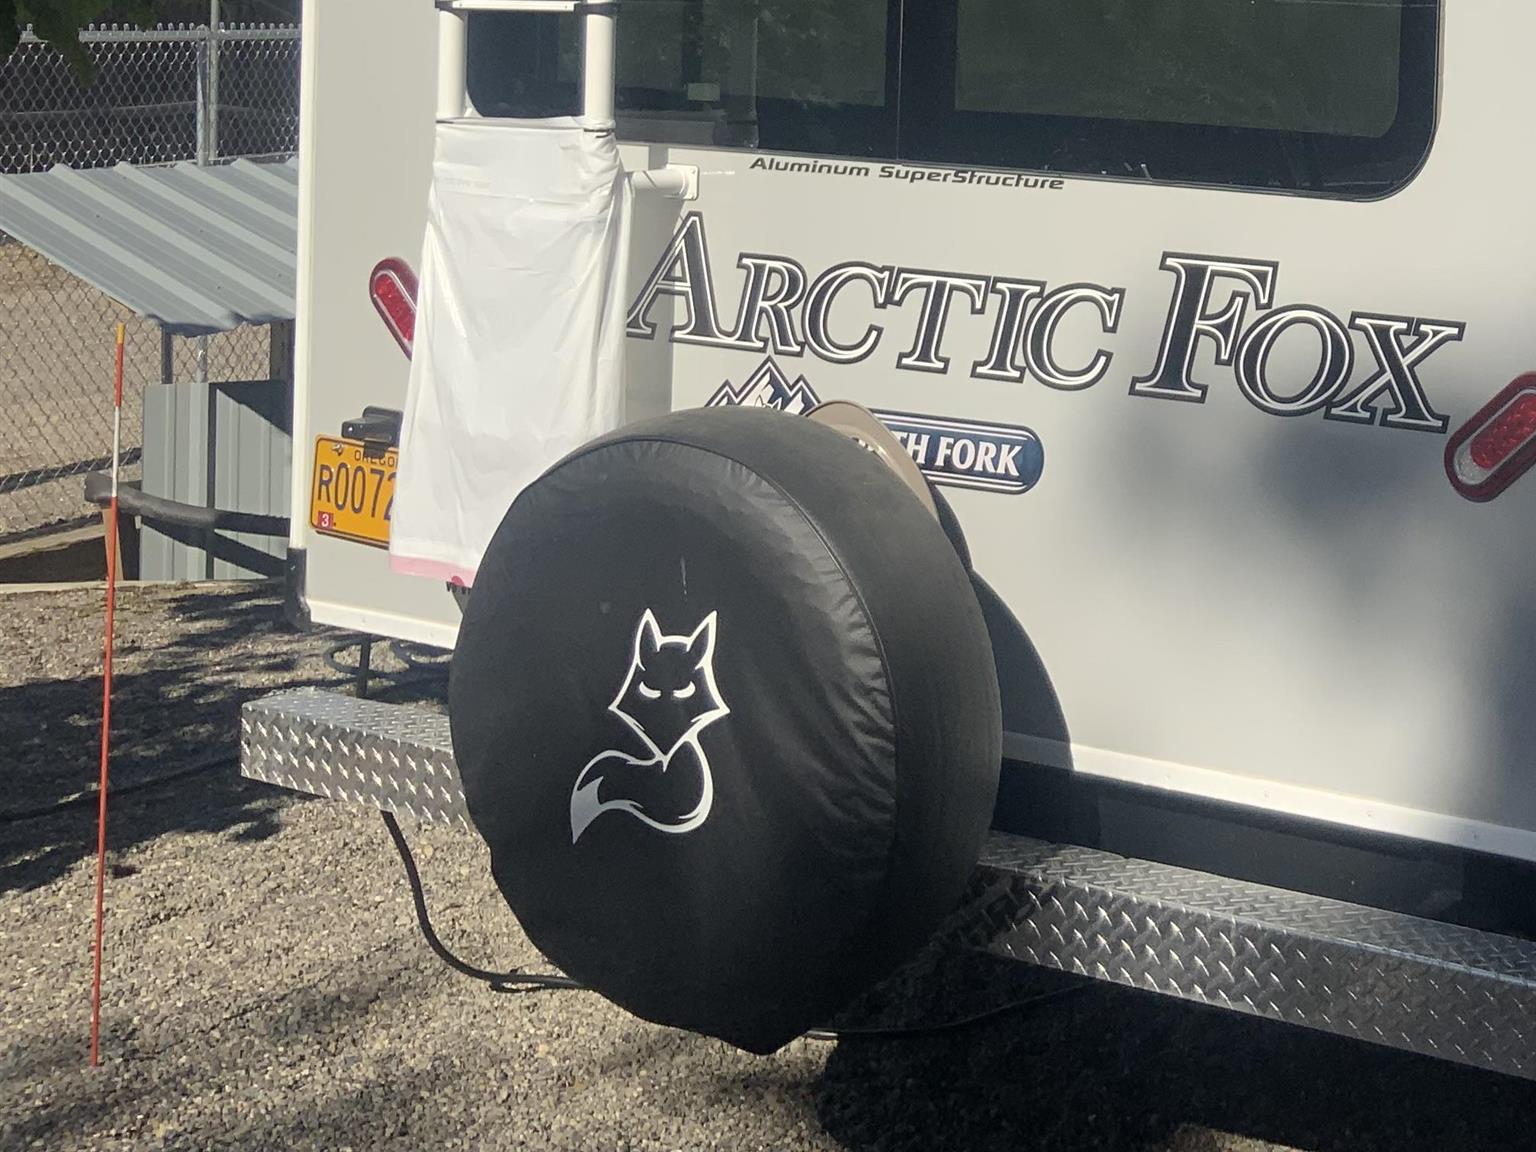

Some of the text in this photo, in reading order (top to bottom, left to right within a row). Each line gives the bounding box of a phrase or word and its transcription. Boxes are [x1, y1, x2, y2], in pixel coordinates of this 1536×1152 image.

[750, 157, 1065, 190] Aluminum SuperStructure
[626, 210, 1465, 433] ARCTIC FOX
[934, 436, 1023, 477] FORK
[321, 514, 330, 528] 3
